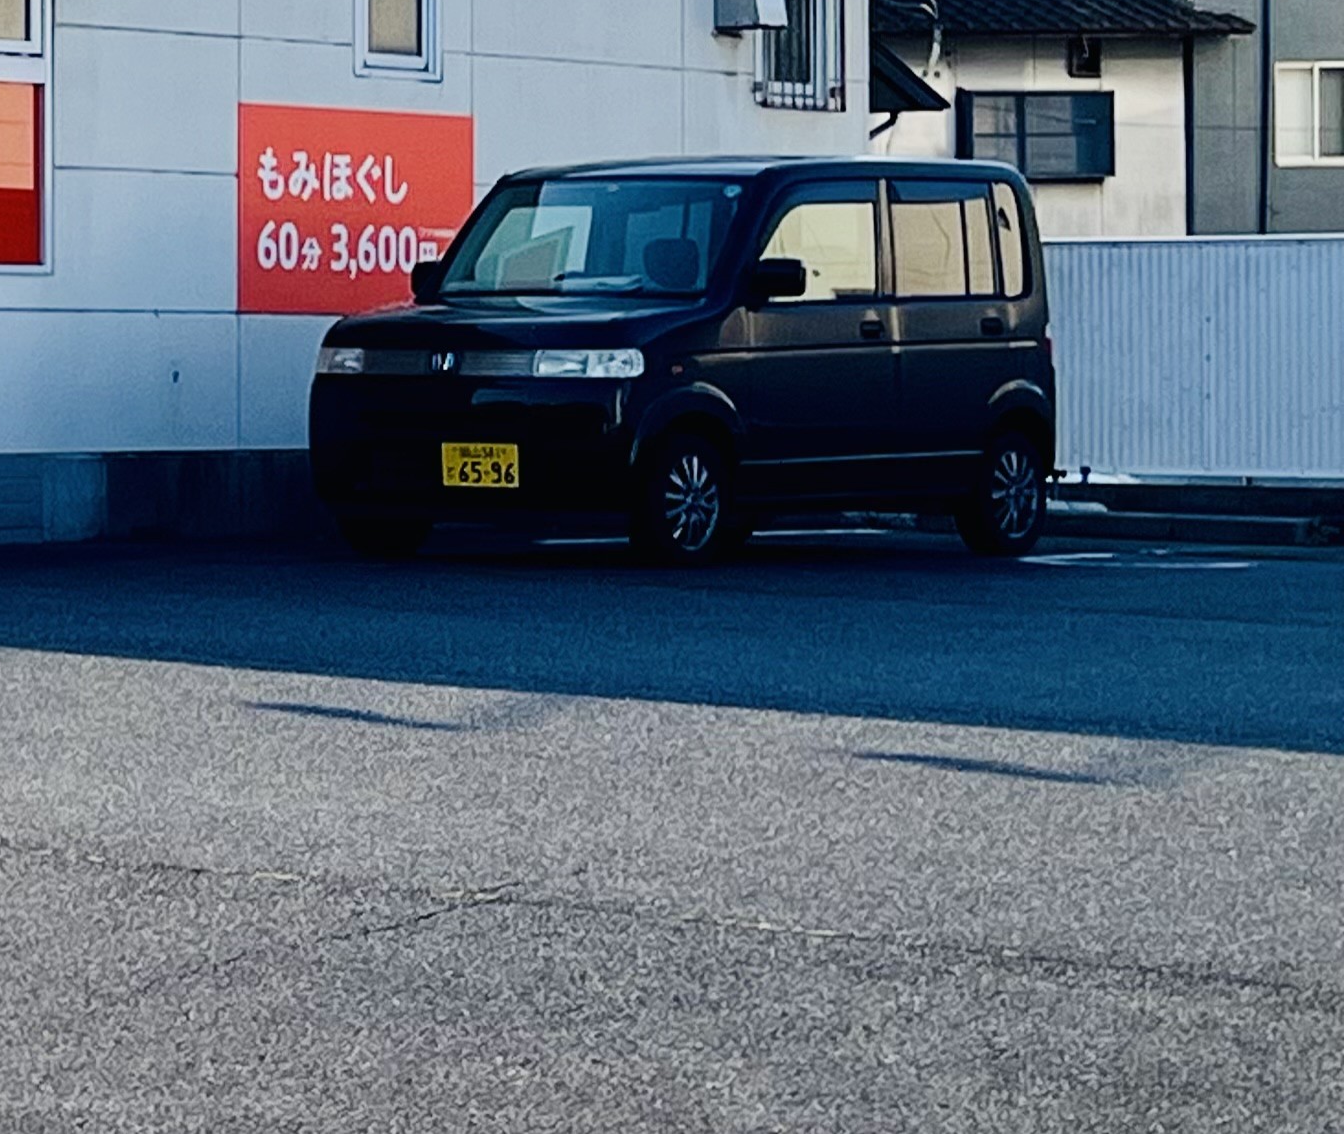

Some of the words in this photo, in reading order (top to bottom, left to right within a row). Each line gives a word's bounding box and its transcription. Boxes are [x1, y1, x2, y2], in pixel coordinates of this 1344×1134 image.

[257, 146, 408, 205] もみほぐし
[257, 219, 322, 271] 60分
